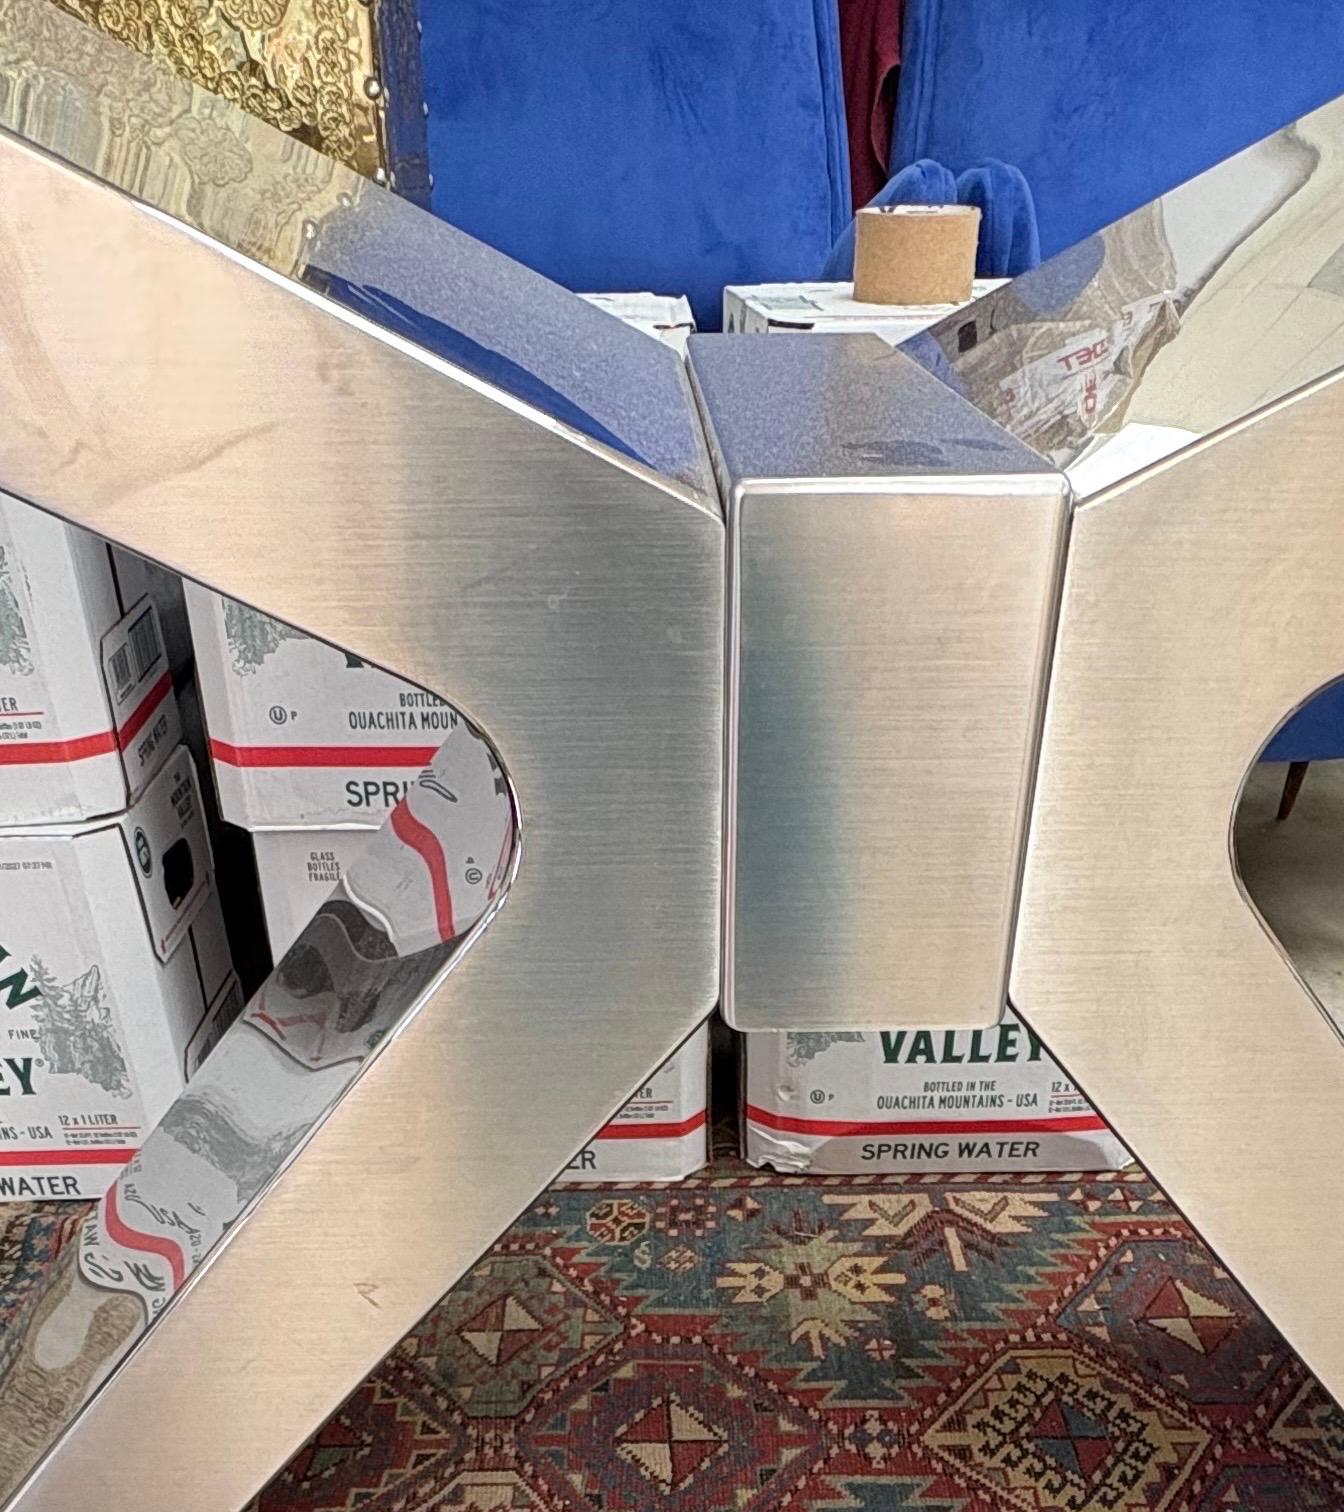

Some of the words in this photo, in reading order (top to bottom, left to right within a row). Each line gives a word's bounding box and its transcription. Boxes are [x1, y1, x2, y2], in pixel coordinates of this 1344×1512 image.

[348, 711, 418, 730] OUACHITA
[421, 711, 458, 730] MOUN
[8, 1029, 39, 1040] FINE
[879, 1024, 1044, 1064] VALLEY
[923, 1081, 962, 1093] BOTTLED
[964, 1081, 976, 1092] IN
[978, 1080, 997, 1092] THE
[877, 1095, 936, 1110] OUACHITA
[938, 1094, 1004, 1109] MOUNTAINS
[1016, 1093, 1038, 1108] USA
[88, 1114, 118, 1125] LITER
[28, 1126, 53, 1140] USA
[861, 1143, 949, 1160] SPRING
[957, 1142, 1040, 1158] WATER
